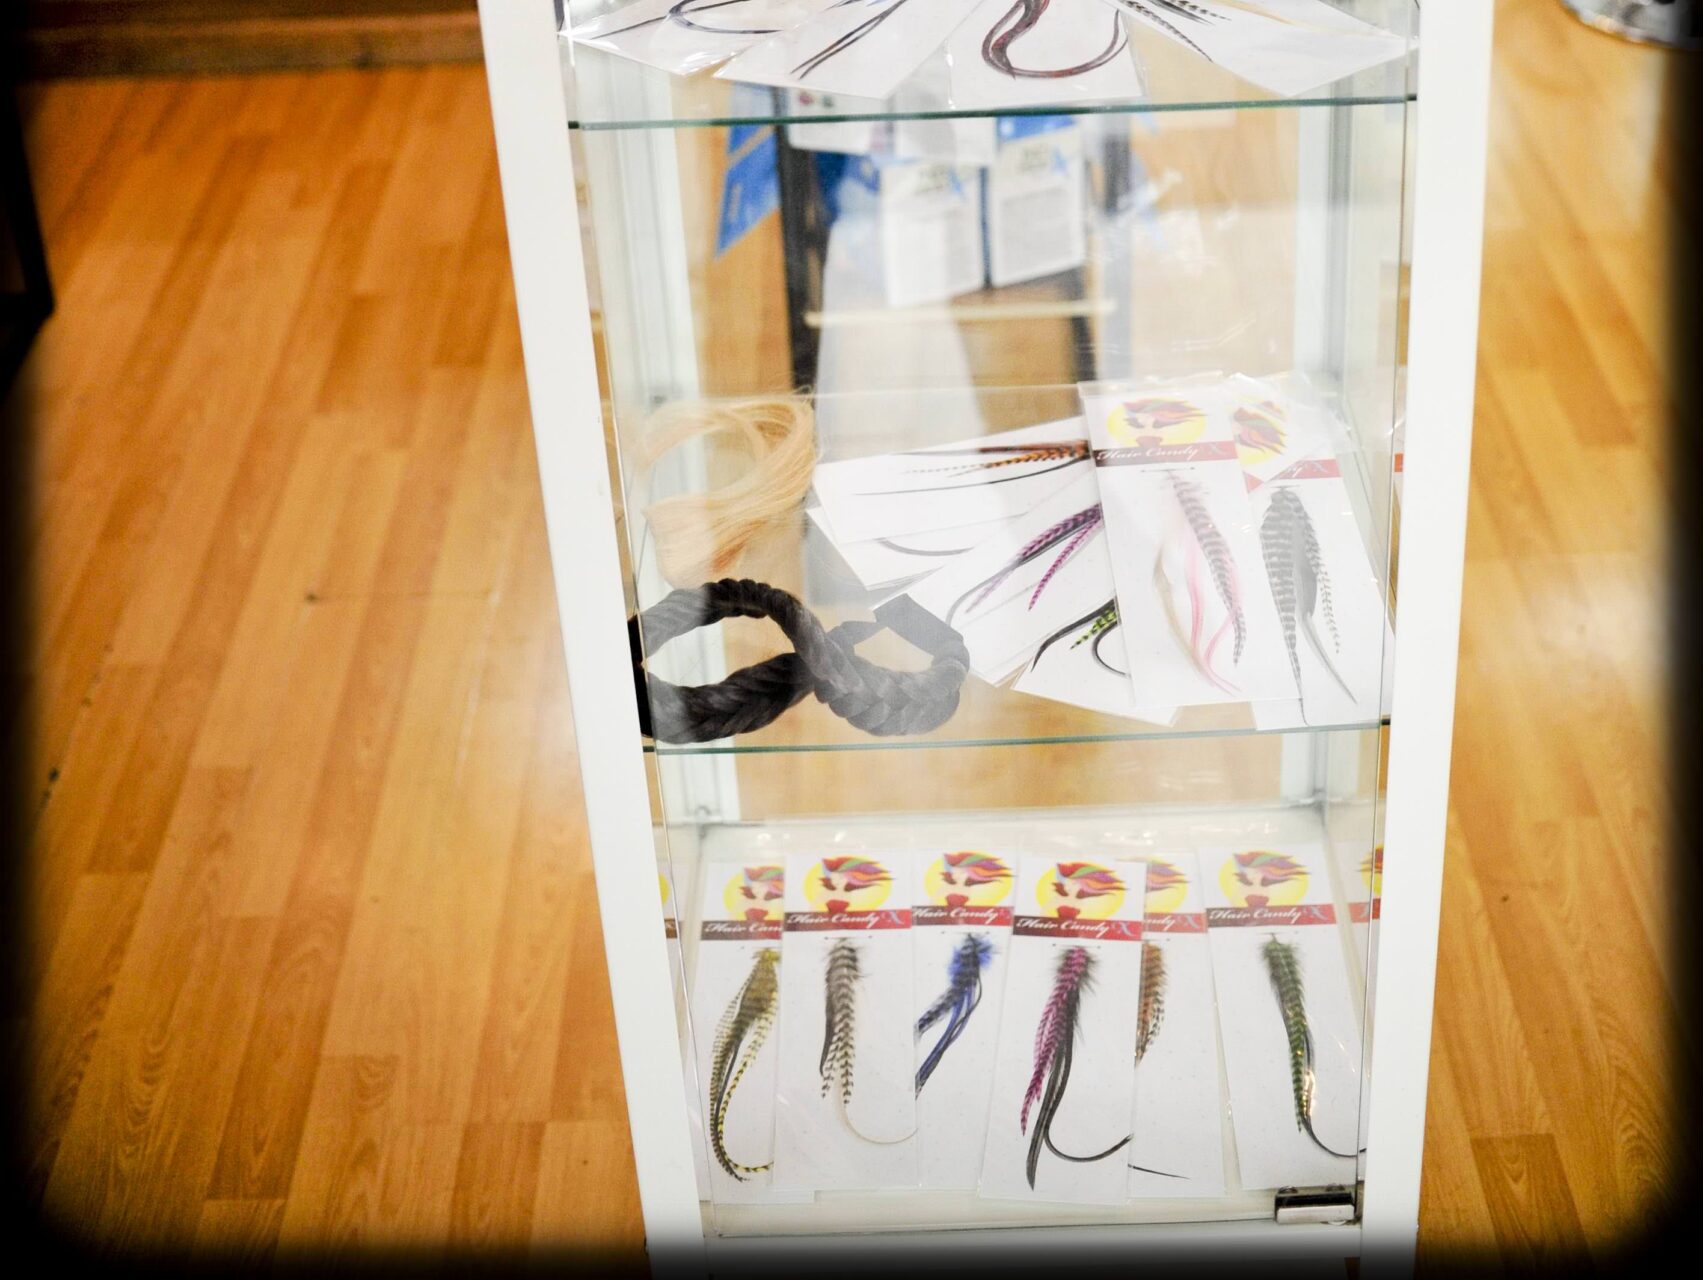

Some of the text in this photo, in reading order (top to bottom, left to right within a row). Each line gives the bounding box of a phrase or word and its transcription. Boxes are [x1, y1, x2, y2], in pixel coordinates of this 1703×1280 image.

[1097, 447, 1199, 462] Hair Candy
[787, 911, 881, 929] Hair Candy
[912, 907, 999, 926] Hair Candy
[1143, 914, 1177, 931] ndy
[1209, 907, 1303, 924] Hair Candy
[704, 922, 782, 933] Hair Can
[1016, 917, 1110, 938] Hair Candy
